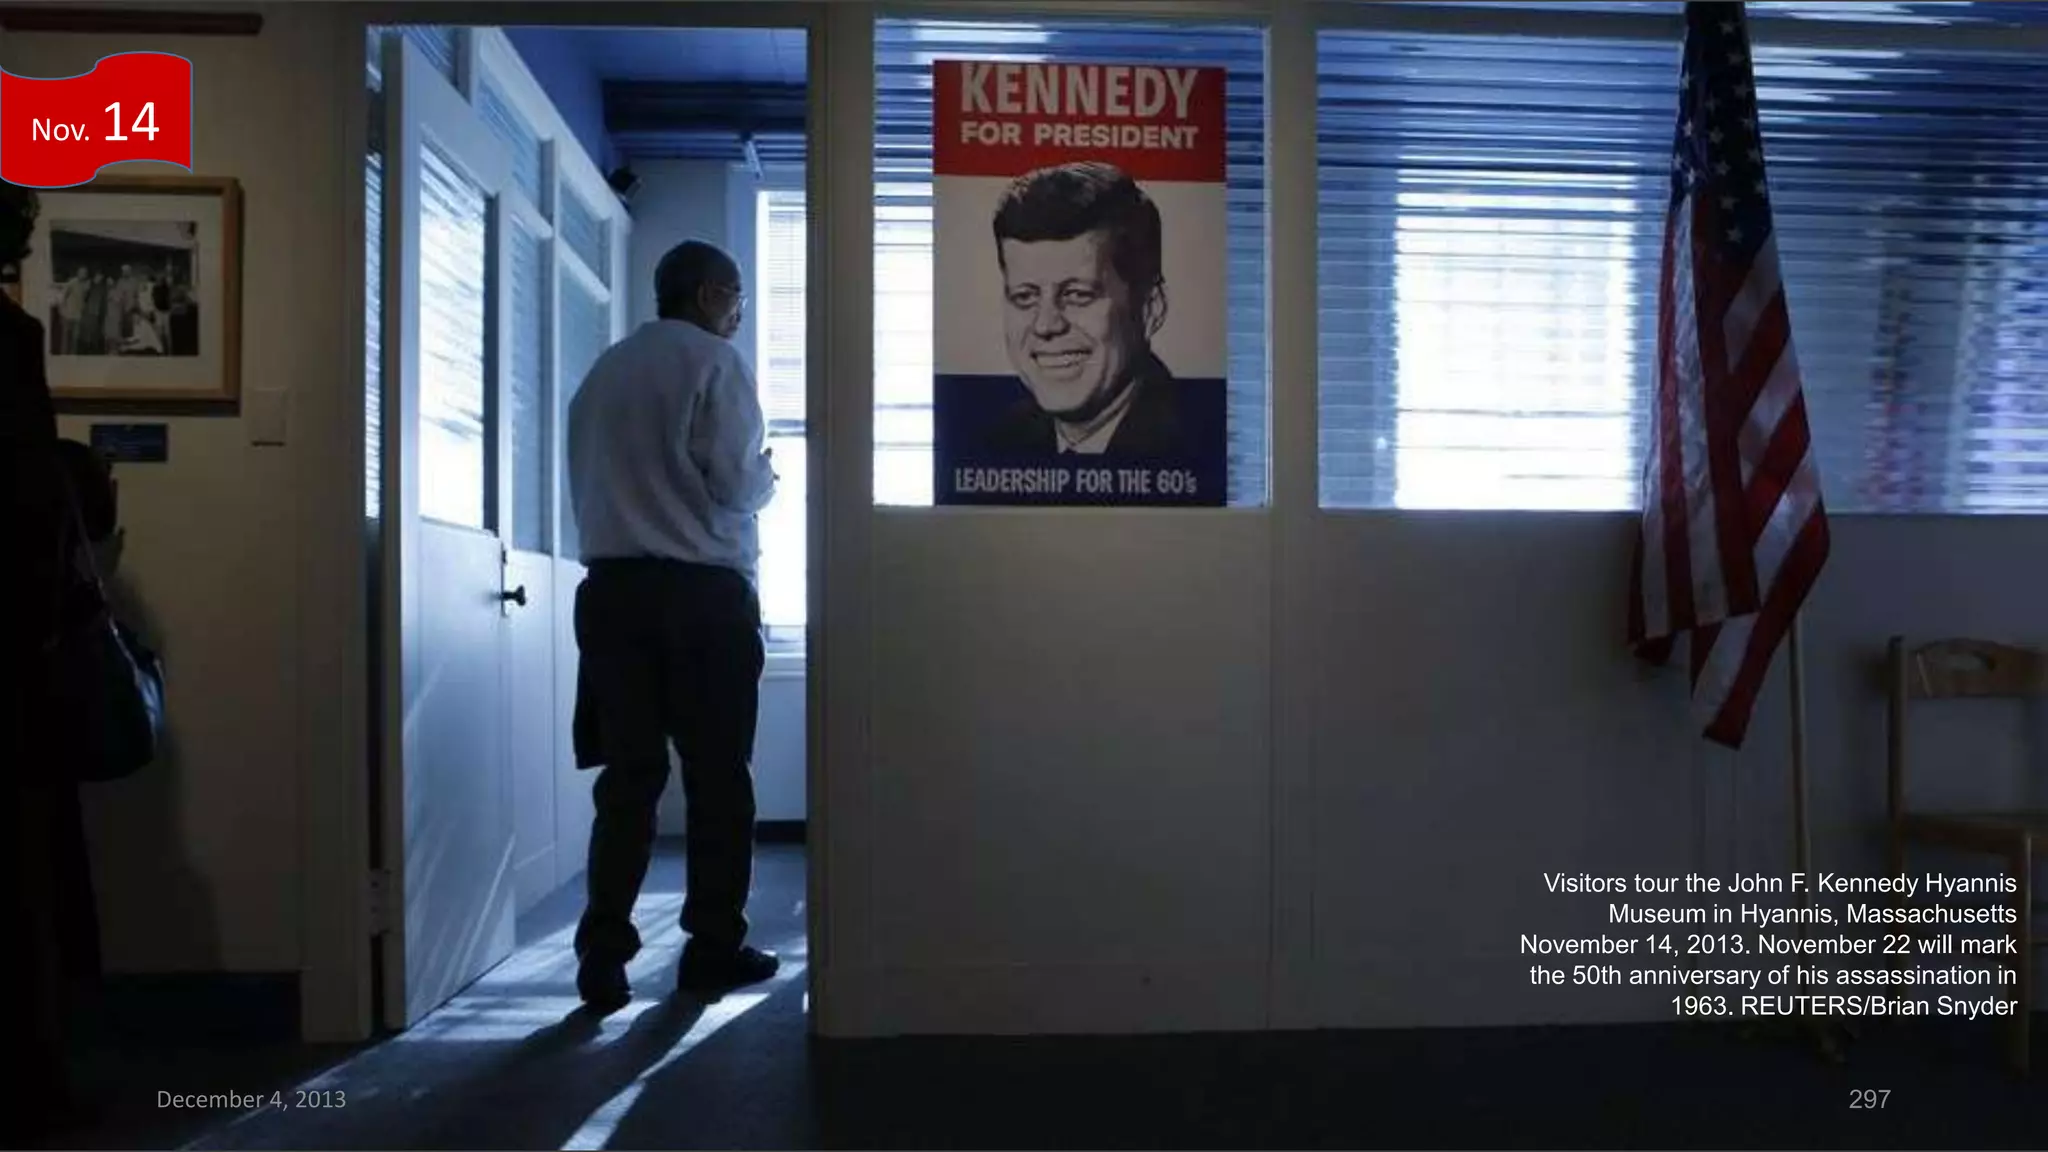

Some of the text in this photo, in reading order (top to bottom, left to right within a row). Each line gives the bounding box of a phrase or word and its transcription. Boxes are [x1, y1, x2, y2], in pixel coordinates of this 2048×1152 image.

[960, 62, 1198, 117] KENNEDY
[961, 120, 1198, 149] FOR PRESIDENT
[955, 468, 1070, 493] LEADERSHIP
[1076, 469, 1113, 493] FOR
[1117, 469, 1150, 494] THE
